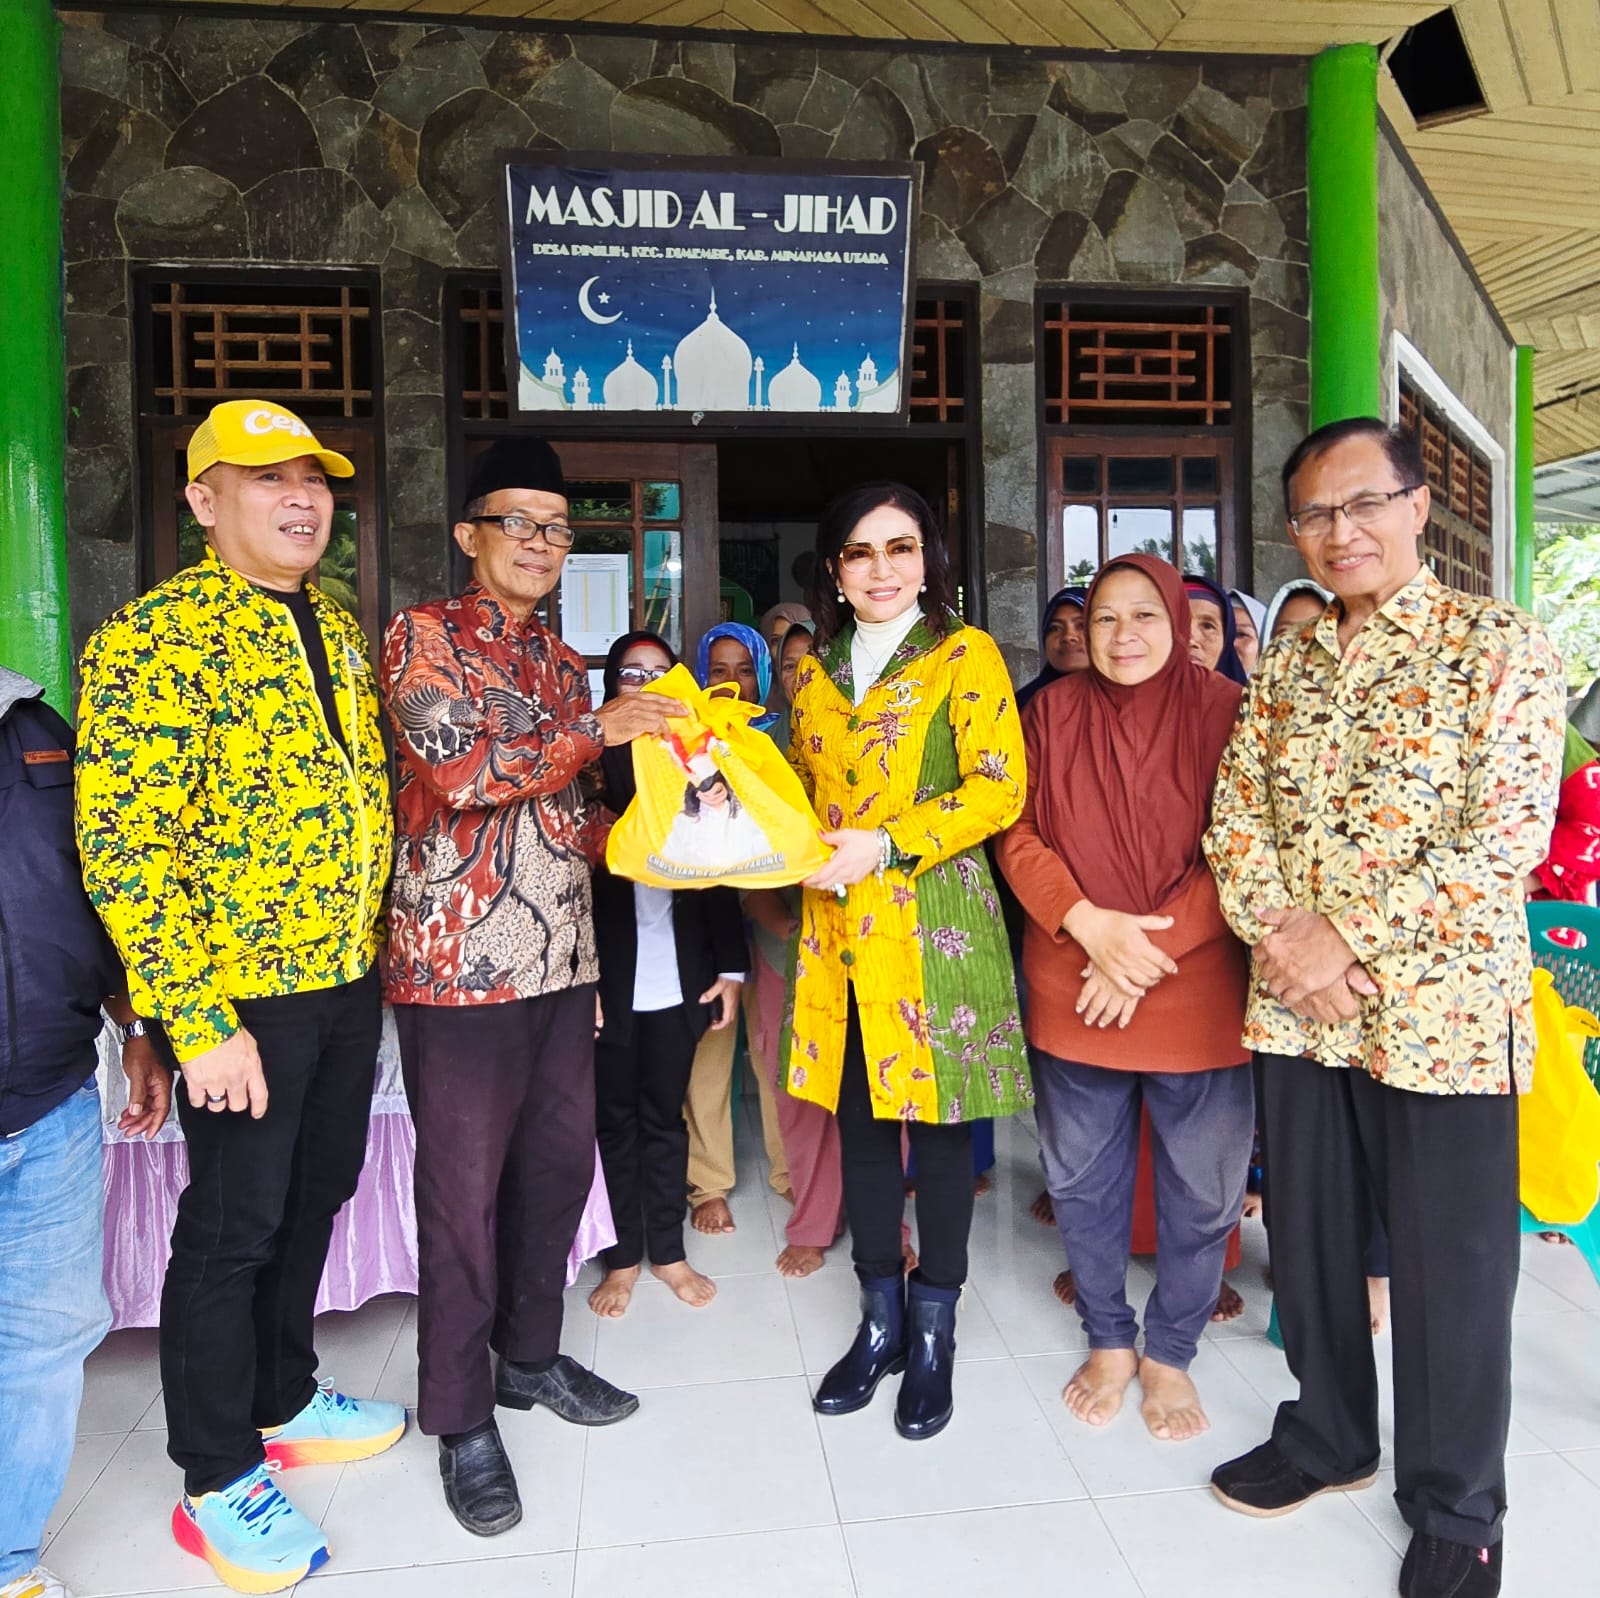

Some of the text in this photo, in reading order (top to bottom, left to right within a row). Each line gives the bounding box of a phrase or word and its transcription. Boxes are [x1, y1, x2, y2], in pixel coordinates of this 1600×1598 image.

[525, 184, 683, 229] MASJID
[688, 189, 747, 231] AL
[773, 194, 898, 236] JIHAD
[532, 243, 569, 257] DESA
[631, 246, 664, 259] KEC.
[735, 248, 769, 262] KAB.
[770, 250, 842, 264] MINAHASA
[843, 251, 890, 265] UTARA
